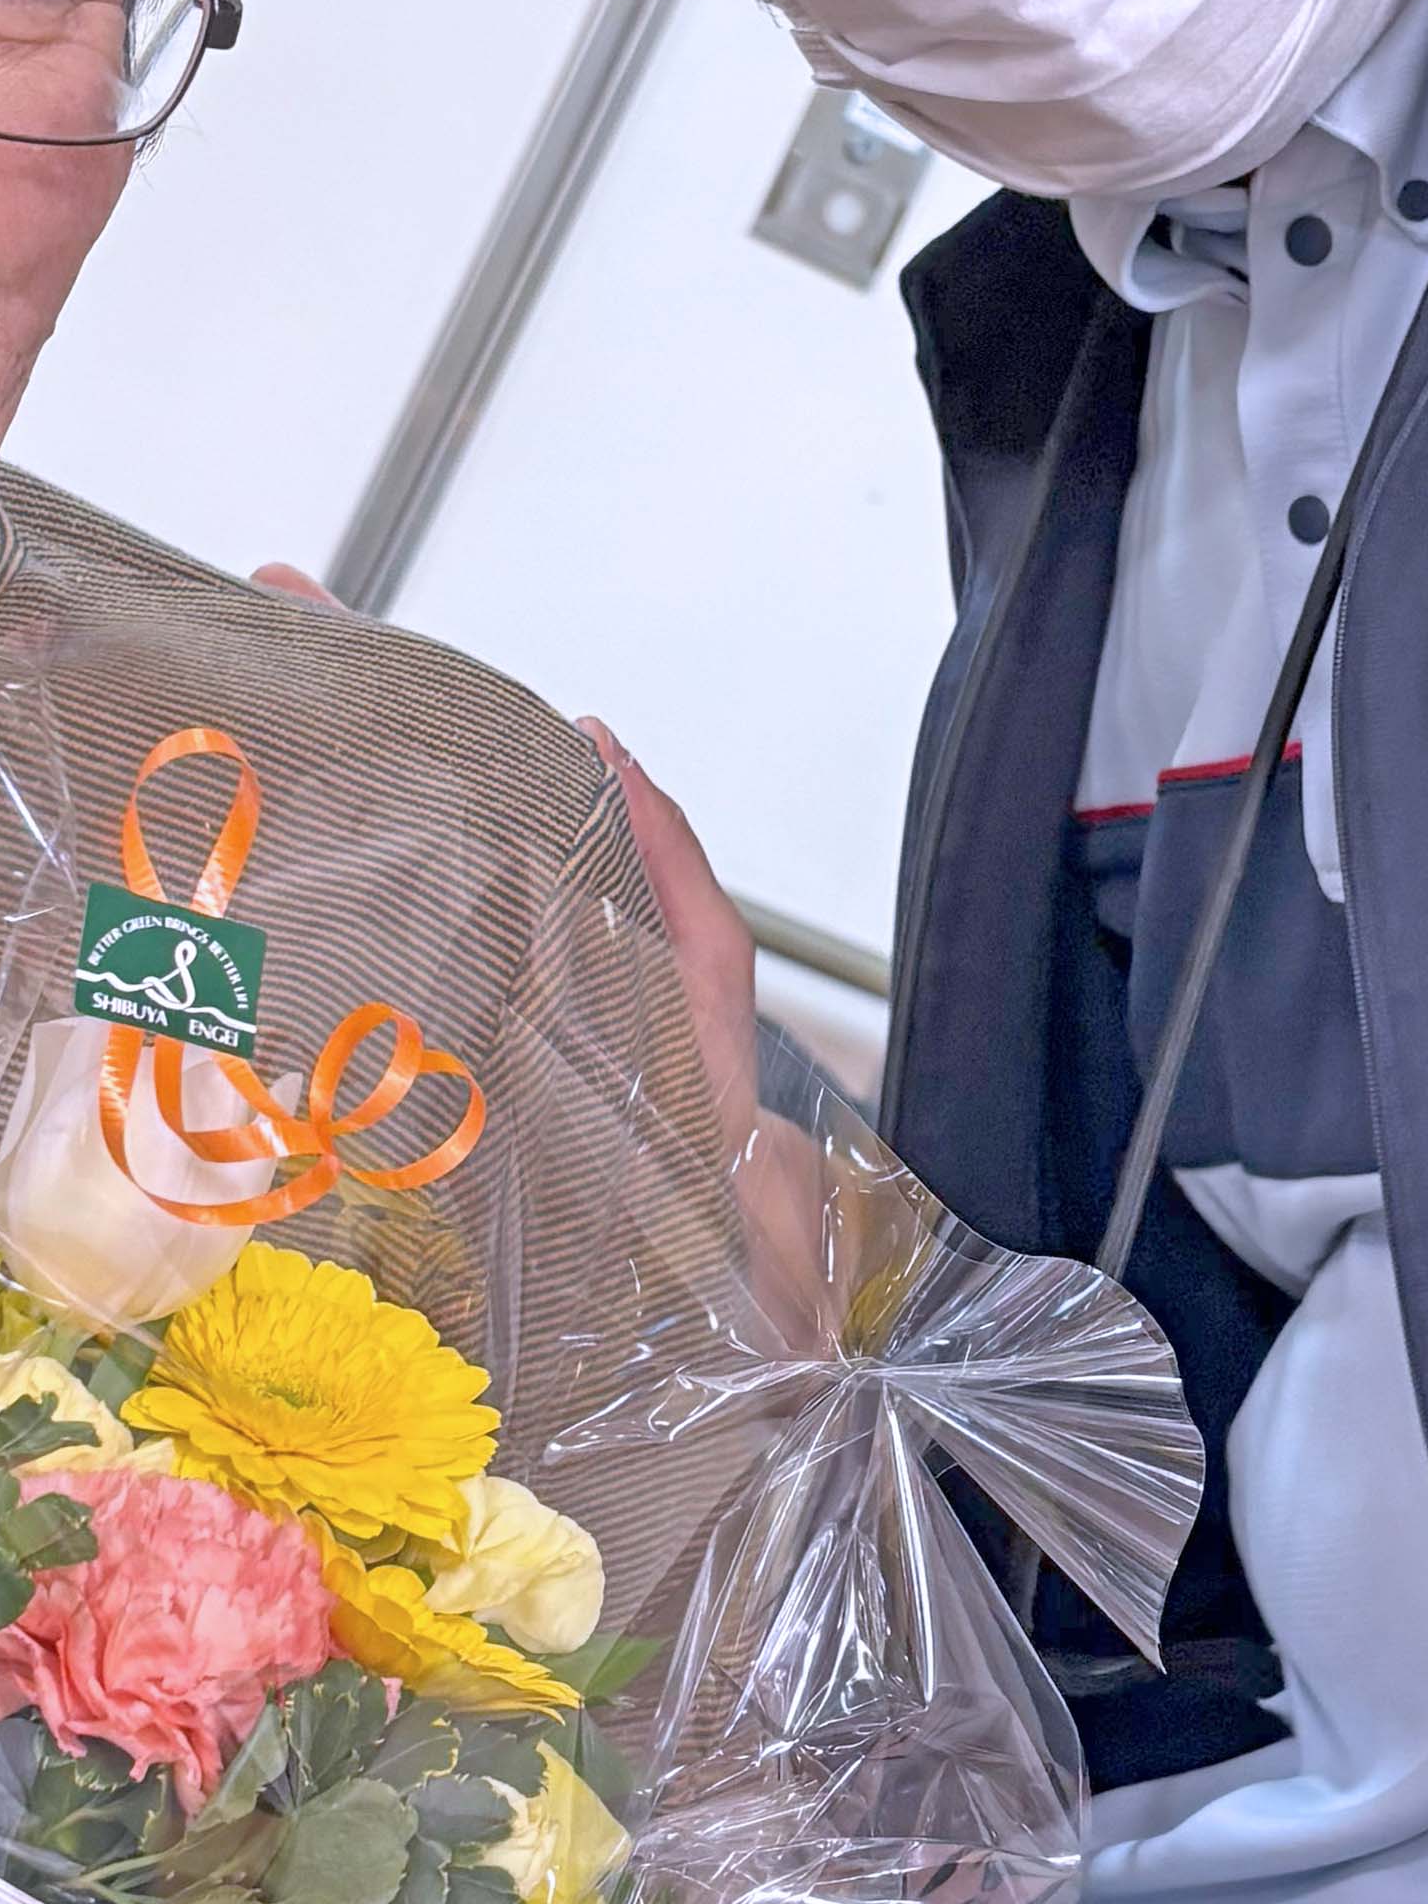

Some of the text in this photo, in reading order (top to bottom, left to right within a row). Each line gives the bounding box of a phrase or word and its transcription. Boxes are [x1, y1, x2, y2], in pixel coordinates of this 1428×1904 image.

[87, 927, 123, 966] BETTER
[122, 914, 163, 934] GREEN
[165, 916, 211, 944] BRINGS
[208, 940, 242, 984] BETTER
[92, 991, 240, 1047] SHIBUYA ENGEI
